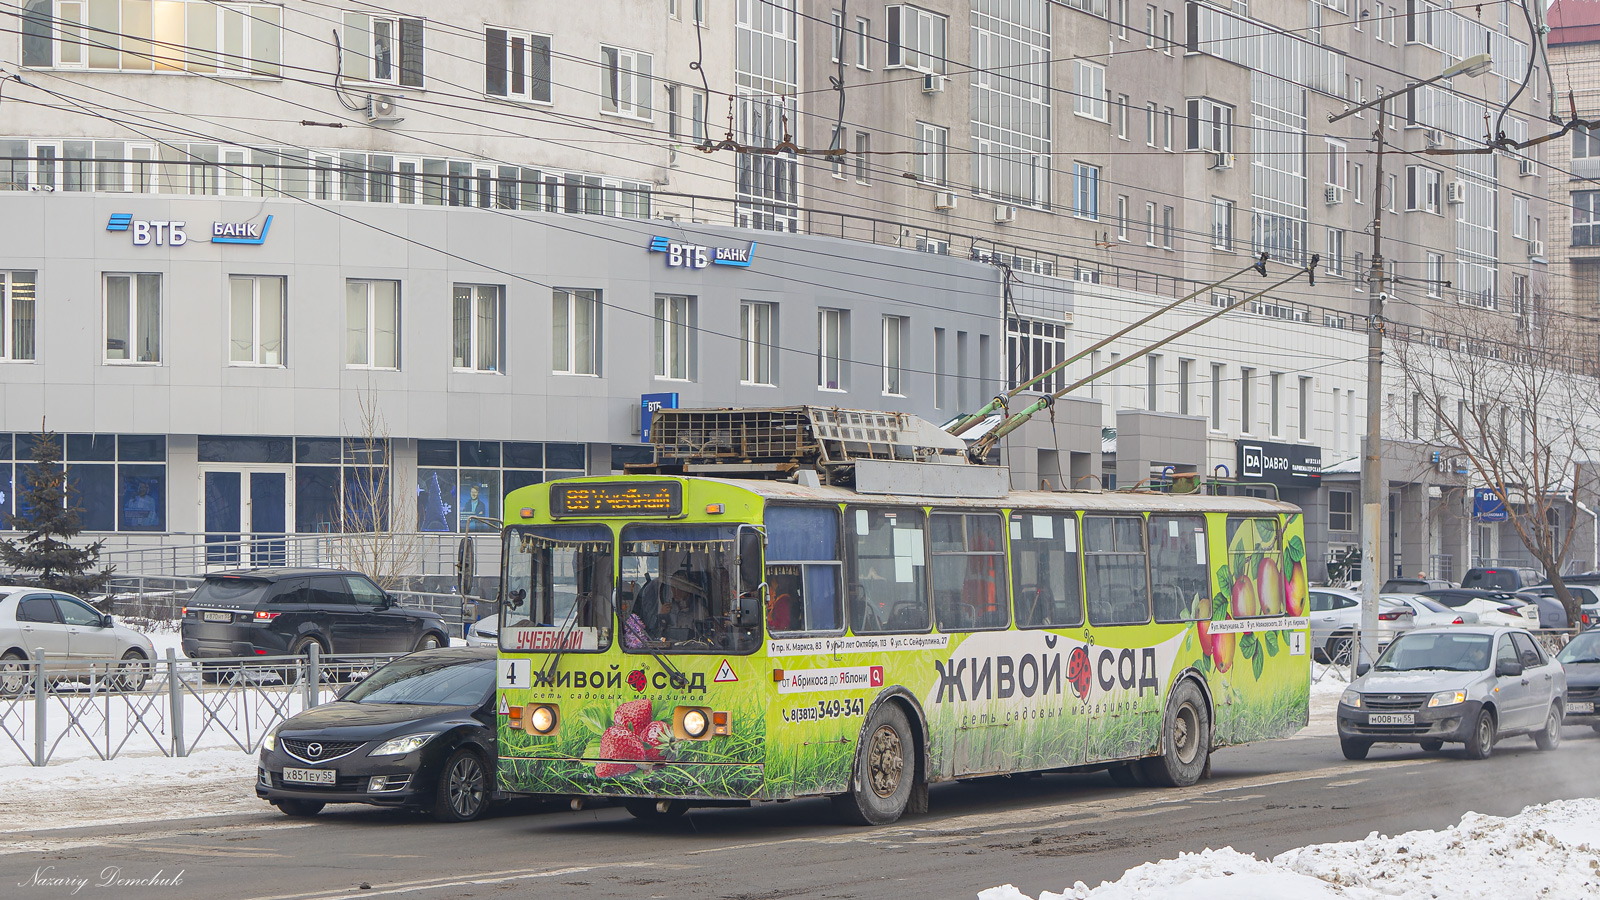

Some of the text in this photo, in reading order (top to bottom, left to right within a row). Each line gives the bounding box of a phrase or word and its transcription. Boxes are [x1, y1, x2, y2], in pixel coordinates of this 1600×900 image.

[133, 220, 257, 246] ВТБ БАНК
[668, 243, 747, 268] ВТБ БАНК
[1246, 455, 1289, 471] DA DABRO
[517, 630, 584, 649] УЧЕБНЫЙ
[776, 645, 784, 653] пр.
[786, 643, 792, 651] К.
[793, 642, 814, 652] Маркса,
[904, 638, 908, 646] С.
[941, 636, 948, 644] 27
[1295, 634, 1300, 652] 4
[506, 662, 517, 685] 4
[721, 668, 730, 679] У
[791, 675, 828, 688] Абрикоса
[829, 675, 838, 686] до
[839, 672, 868, 684] Яблони
[570, 692, 623, 700] садовых
[790, 698, 864, 723] 8(3812) 349-341
[962, 700, 1139, 726] сеть садовых магазинов
[322, 771, 333, 780] 55
